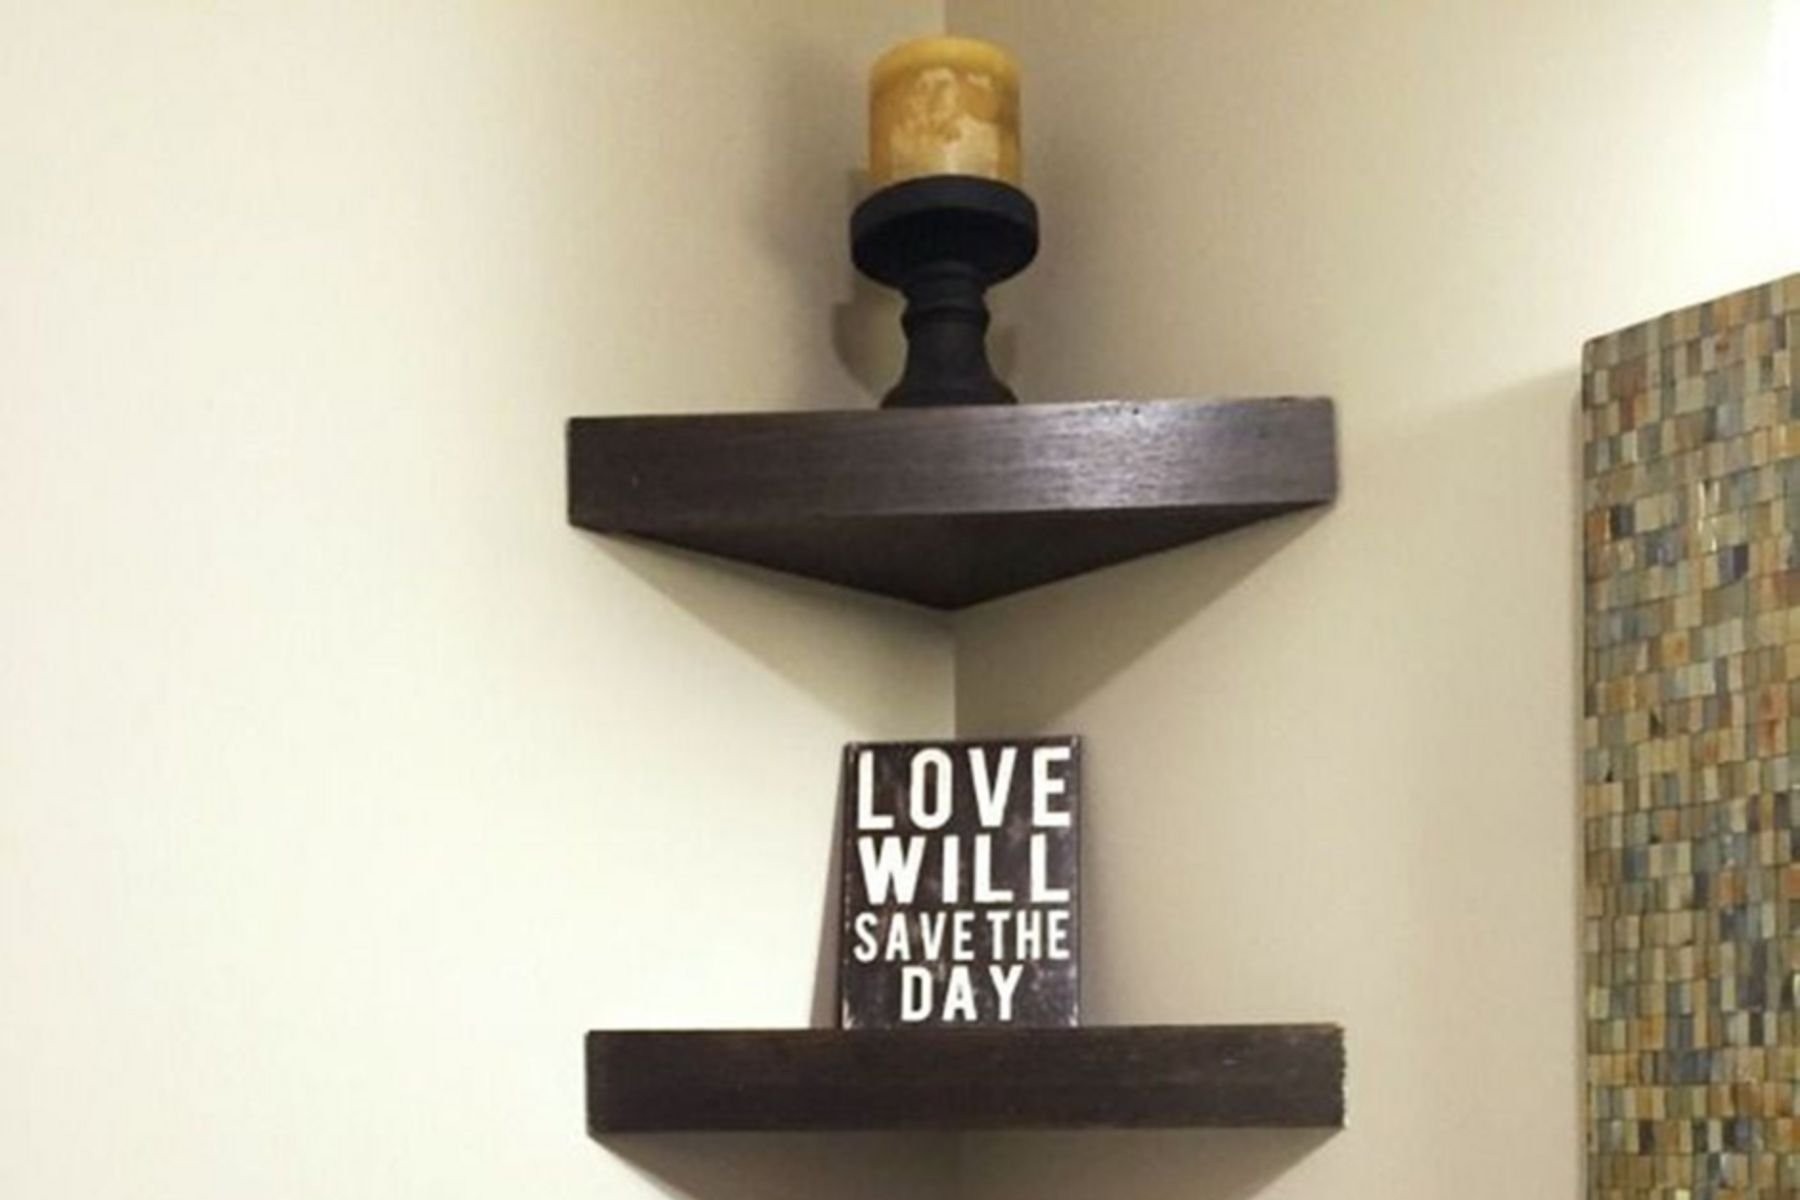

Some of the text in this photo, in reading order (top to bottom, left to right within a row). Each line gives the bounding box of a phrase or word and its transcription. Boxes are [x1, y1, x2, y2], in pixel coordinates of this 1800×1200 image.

[857, 746, 1073, 830] LOVE
[859, 834, 1071, 905] WILL
[853, 908, 1070, 963] SAVE THE
[901, 965, 1024, 1023] DAY
